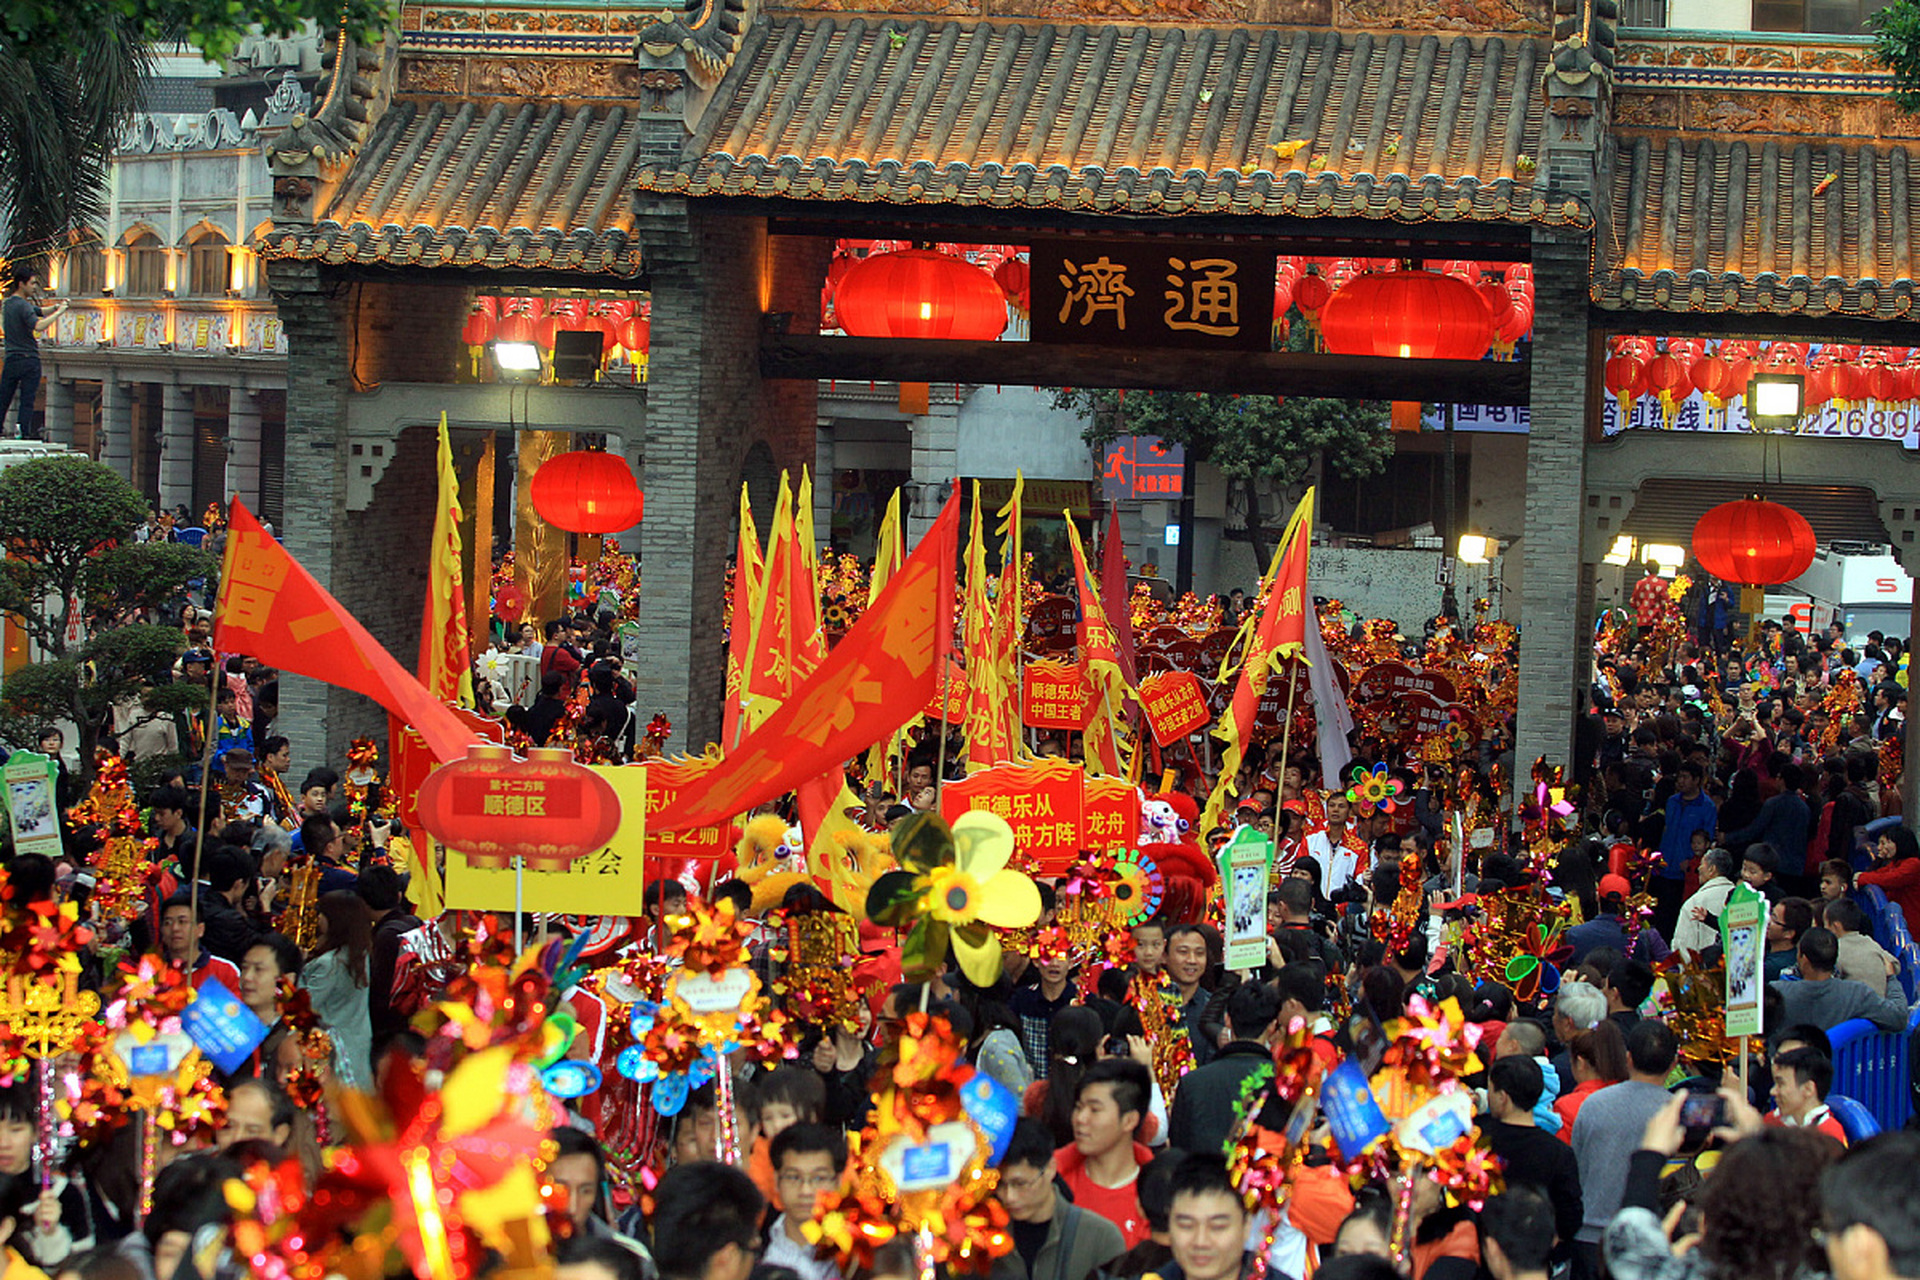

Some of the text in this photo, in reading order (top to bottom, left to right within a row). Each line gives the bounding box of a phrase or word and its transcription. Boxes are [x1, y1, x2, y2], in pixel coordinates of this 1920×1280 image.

[1876, 578, 1898, 593] S
[1031, 682, 1081, 701] 顺德乐从
[1031, 702, 1081, 721] 中国王者
[483, 794, 547, 816] 顺德区
[969, 793, 1055, 819] 顺德乐从
[1086, 811, 1126, 835] 龙舟
